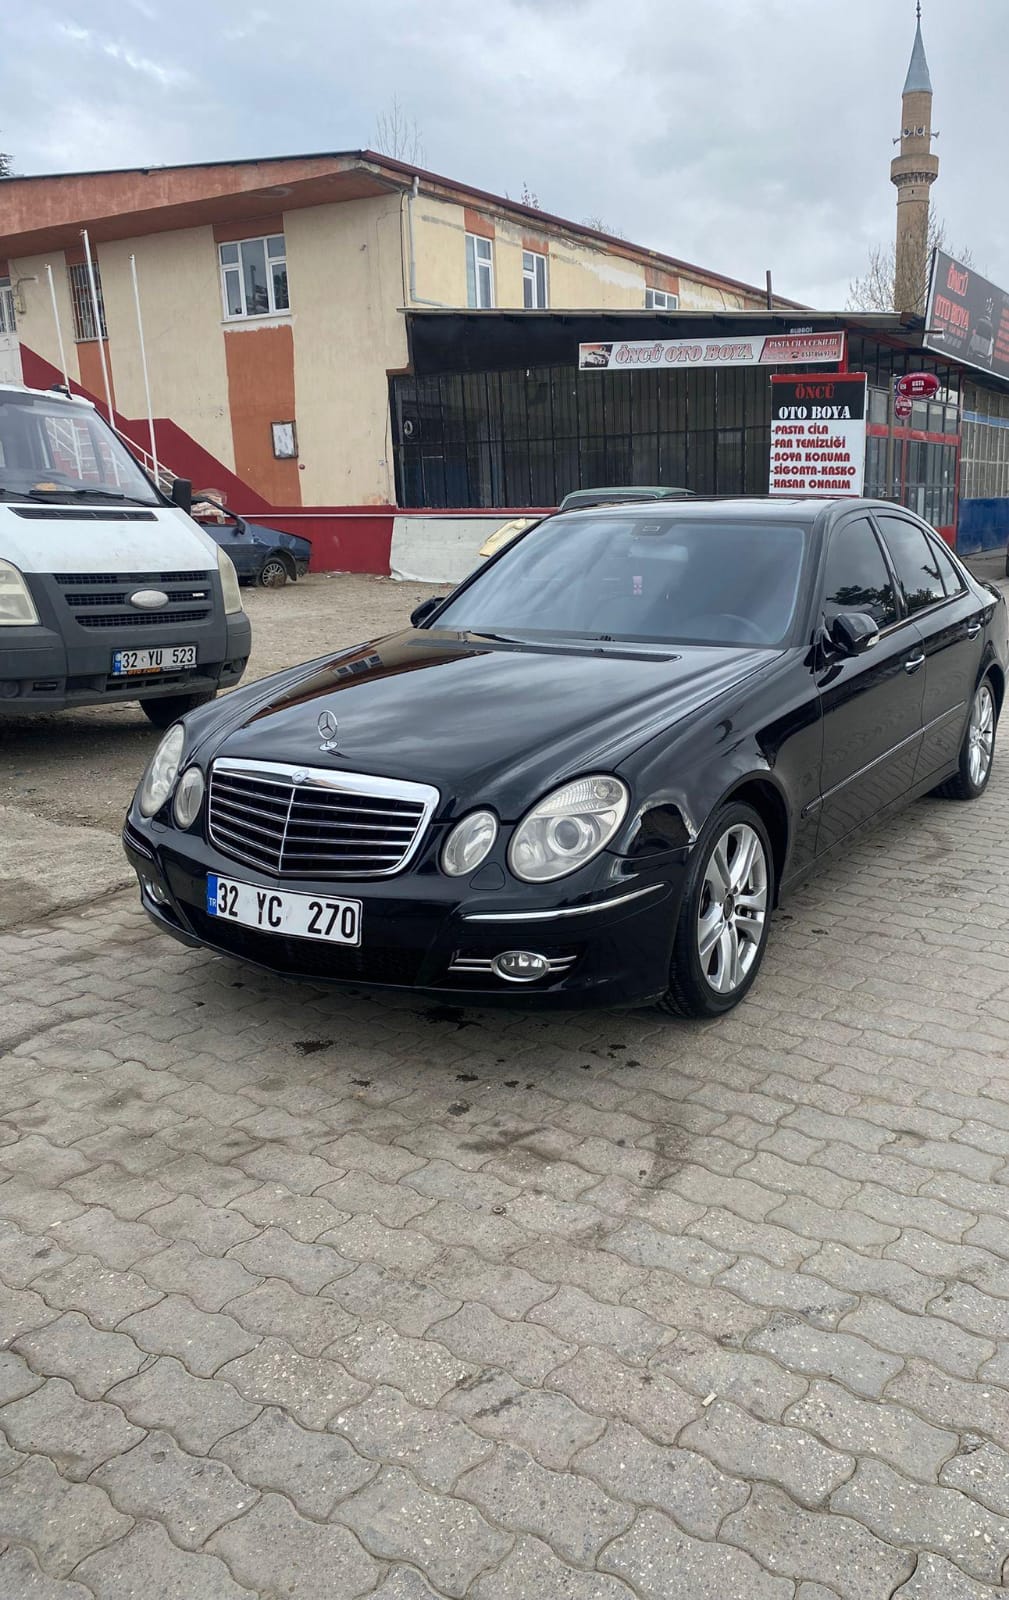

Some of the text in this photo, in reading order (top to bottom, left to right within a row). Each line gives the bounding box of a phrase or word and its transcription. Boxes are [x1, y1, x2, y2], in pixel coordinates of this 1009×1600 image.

[934, 294, 951, 320] OTO
[950, 303, 970, 330] BOYA
[615, 343, 664, 364] ÖNCÜ
[665, 345, 702, 361] OTO
[704, 343, 753, 361] BOYA
[795, 383, 835, 399] ÖNCÜ
[778, 406, 851, 419] OTO BOYA
[807, 422, 829, 435] CİLA
[796, 436, 846, 449] TEMİZLİĞİ
[805, 452, 850, 462] KORUMA
[808, 479, 851, 489] ONARIM
[123, 648, 194, 668] 32 YU 523
[209, 897, 217, 907] TR
[218, 882, 356, 938] 32 YC 270
